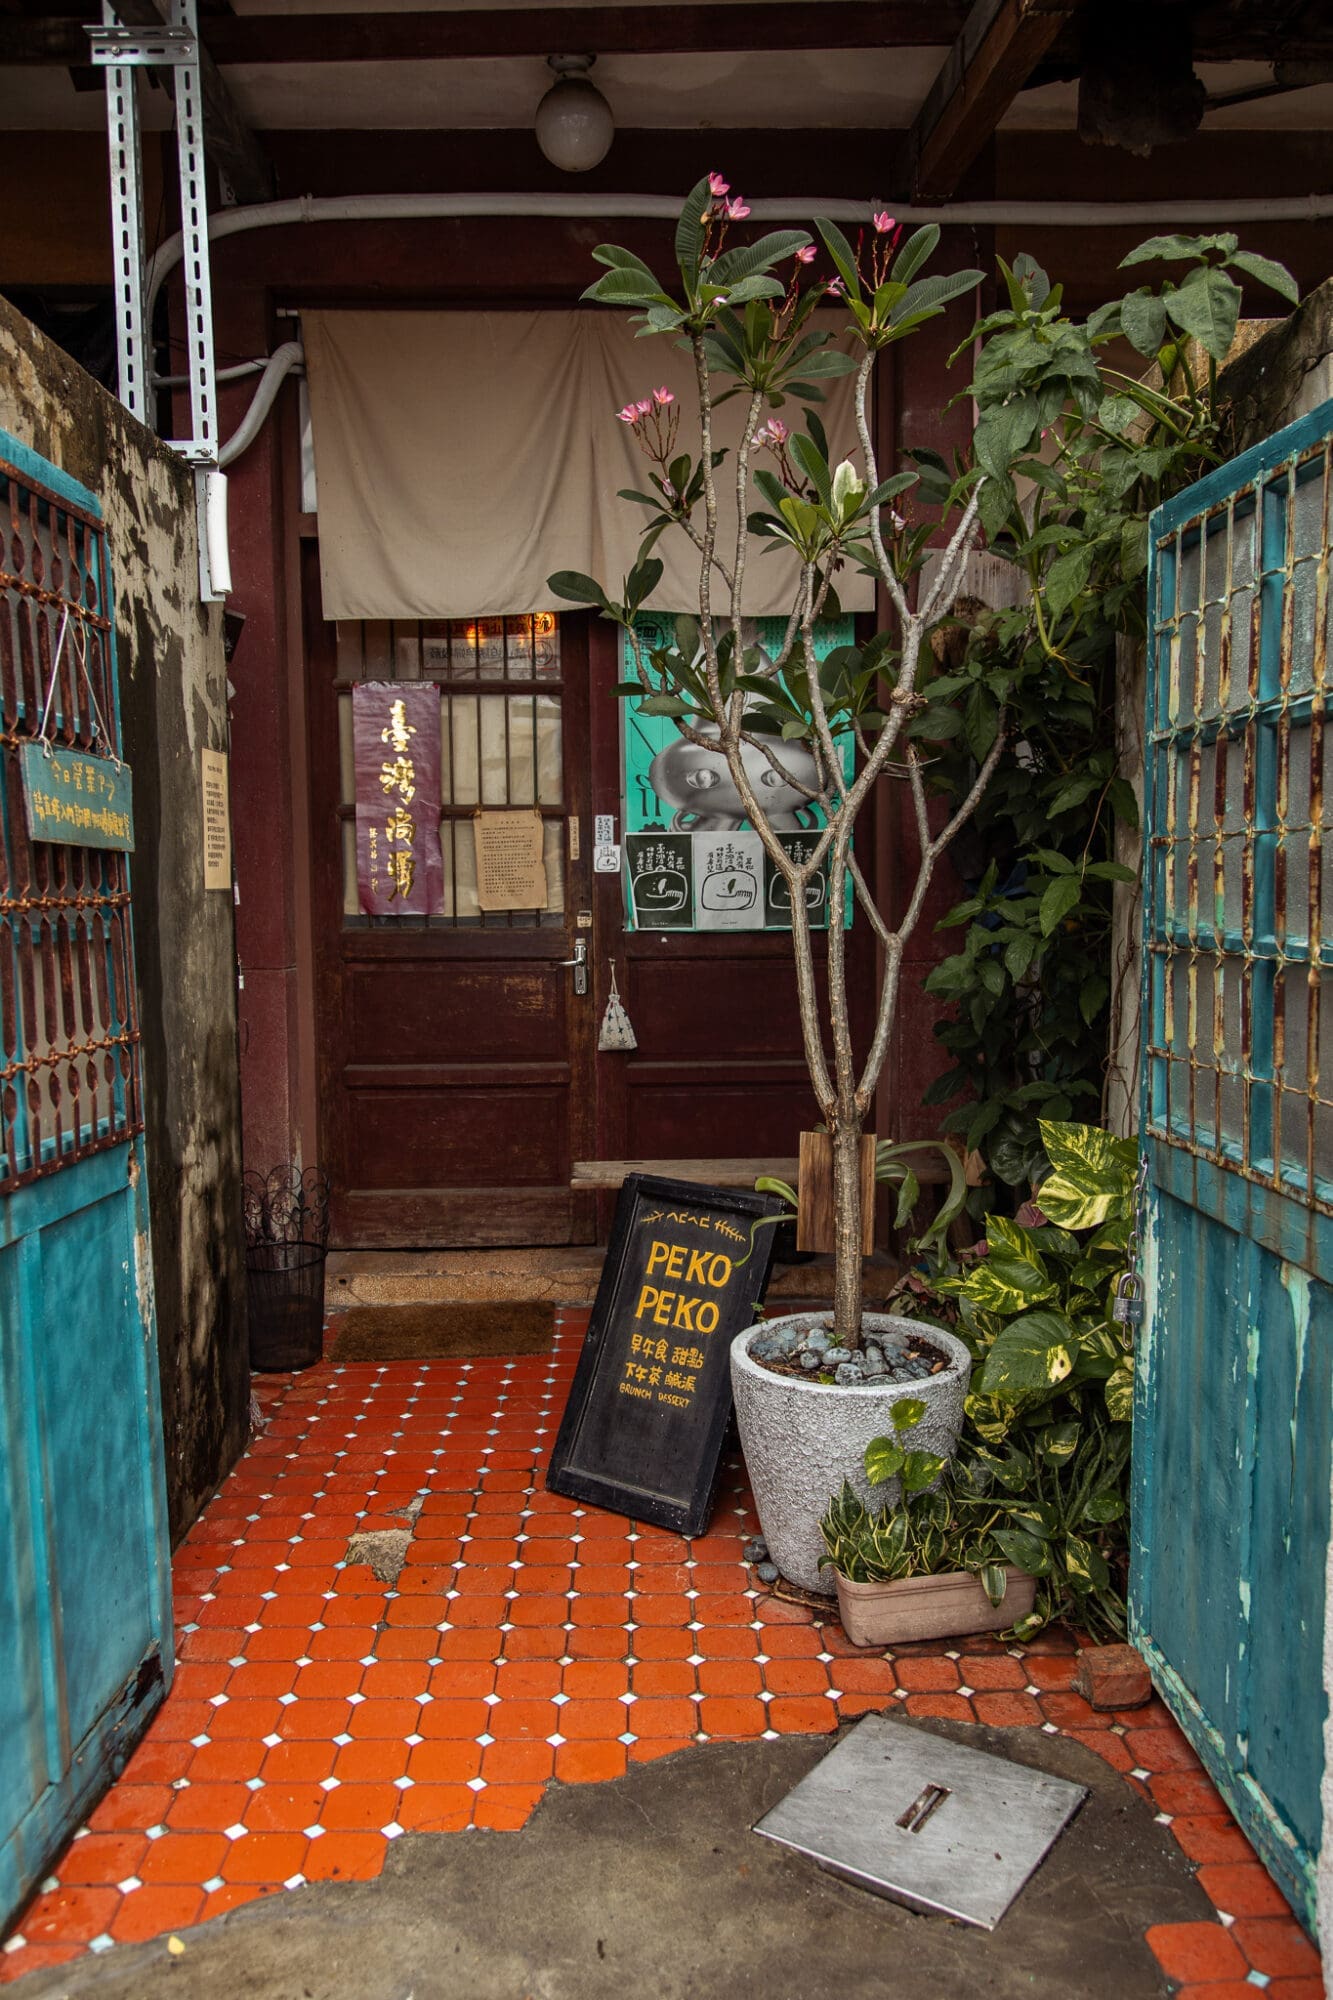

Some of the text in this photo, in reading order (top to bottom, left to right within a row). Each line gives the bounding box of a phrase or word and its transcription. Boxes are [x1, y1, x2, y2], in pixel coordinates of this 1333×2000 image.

[645, 1240, 732, 1288] PEKO
[635, 1285, 720, 1334] PEKO
[631, 1333, 705, 1369] 早午食 甜點
[625, 1361, 663, 1386] 下午茶
[619, 1382, 691, 1409] BRUNCH DESSERT
